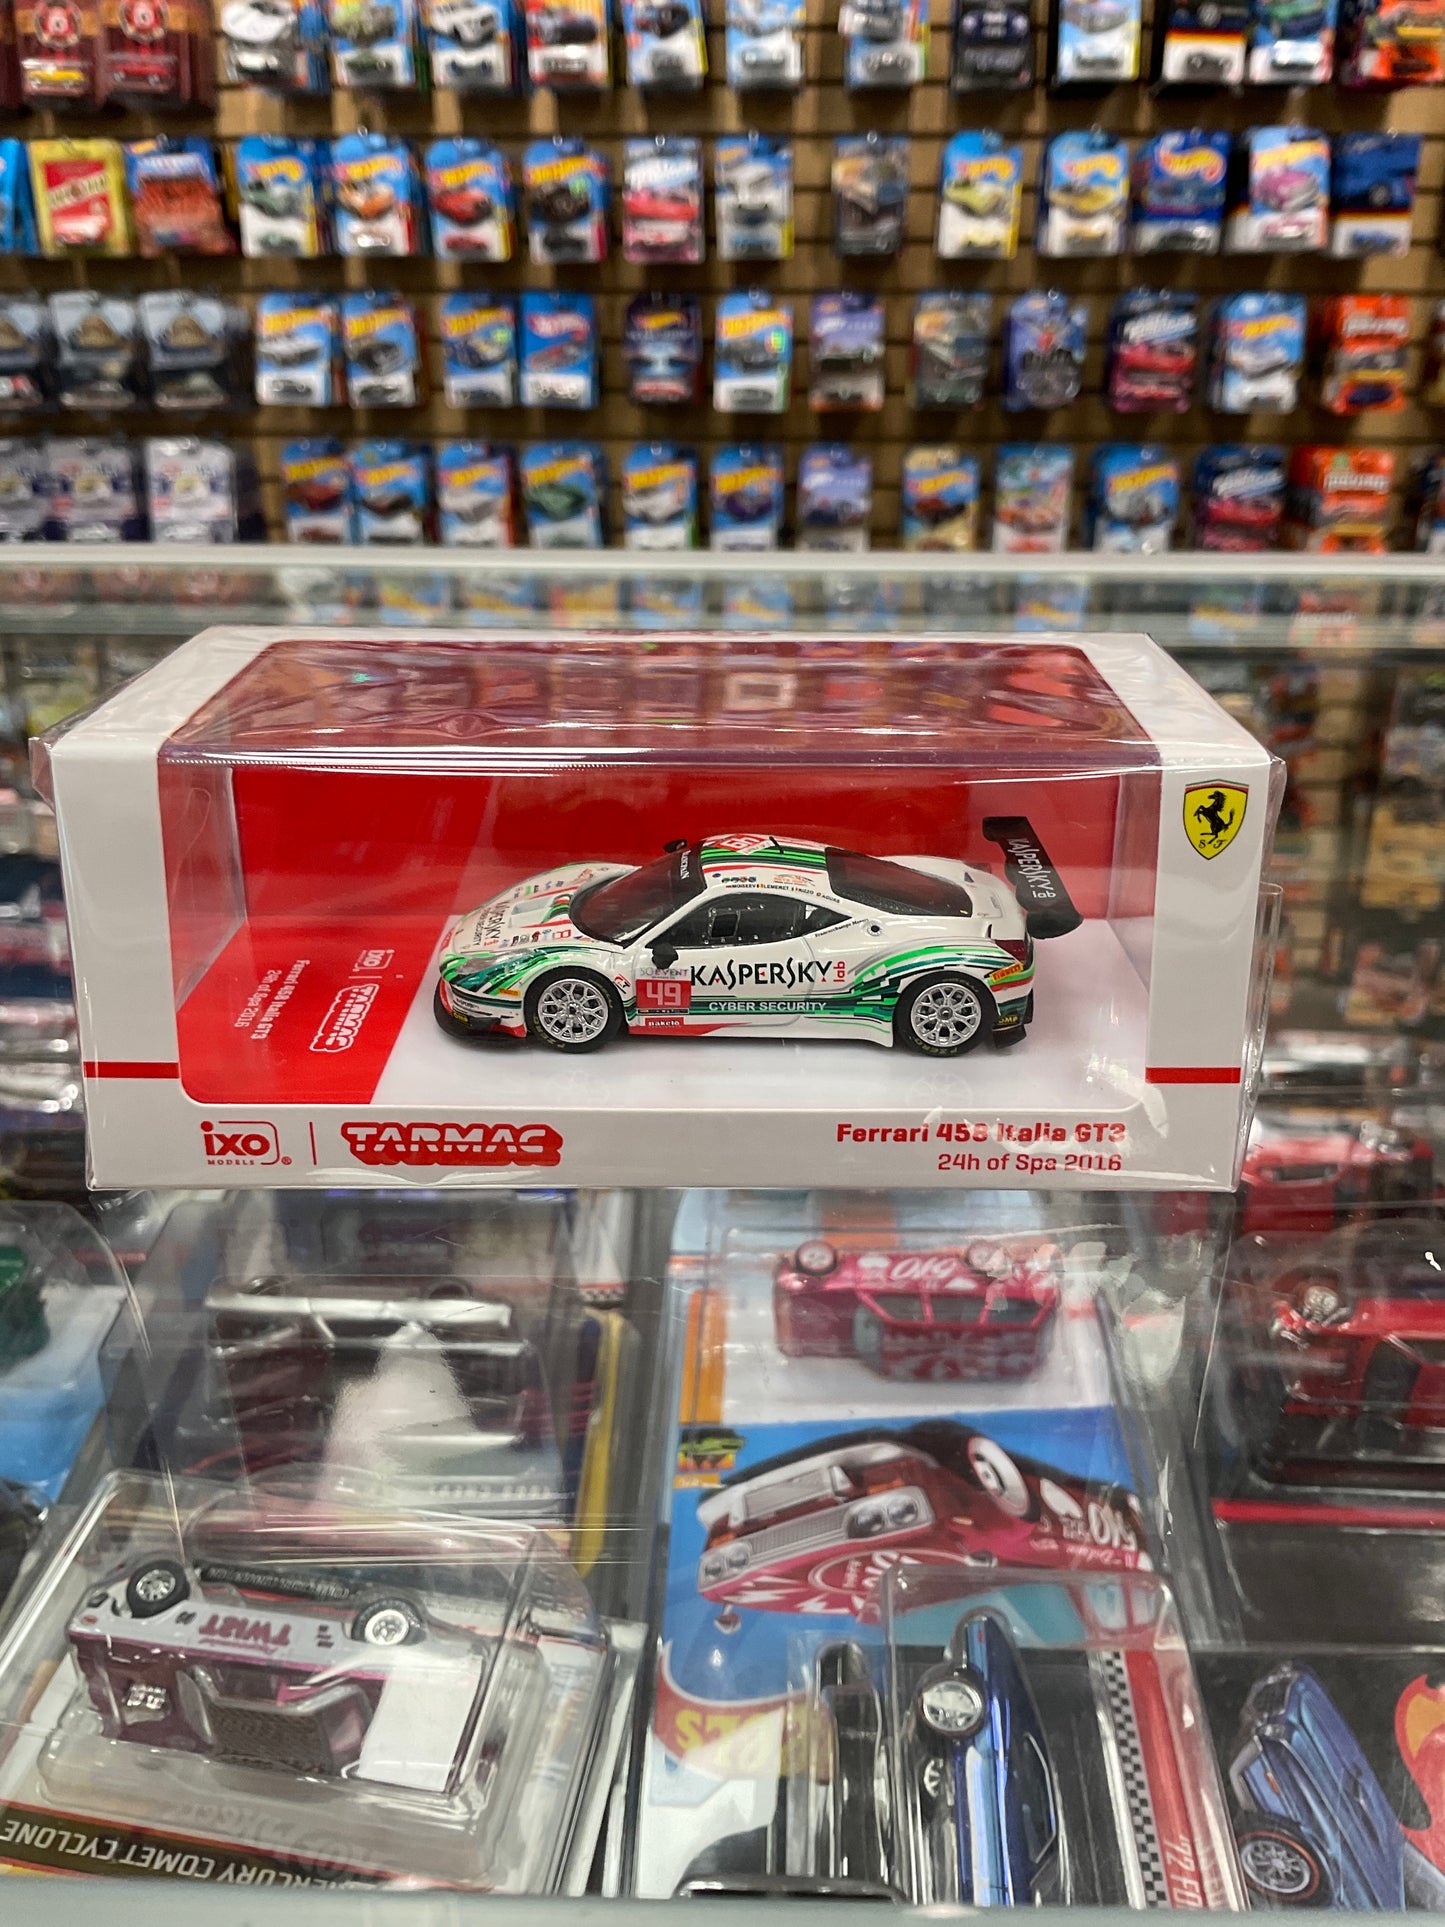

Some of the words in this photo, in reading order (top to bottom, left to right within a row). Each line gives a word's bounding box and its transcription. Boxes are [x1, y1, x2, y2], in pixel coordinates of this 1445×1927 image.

[1008, 837, 1054, 891] KASPERSKY
[1033, 890, 1056, 899] lab
[263, 969, 283, 985] 24h
[284, 959, 311, 985] Ferrari
[690, 957, 832, 990] KASPERSKY
[833, 961, 846, 982] lab
[248, 992, 268, 1006] Spa
[274, 985, 297, 1000] 458
[646, 982, 682, 1006] 49
[234, 1007, 259, 1028] 2016
[261, 1001, 287, 1023] Italia
[709, 1001, 755, 1012] CYBER
[759, 1001, 827, 1012] SECURITY
[250, 1023, 274, 1040] GT3
[200, 1121, 271, 1156] ixo
[345, 1125, 548, 1156] TARMAC
[836, 1122, 929, 1143] Ferrari
[936, 1123, 989, 1143] 458
[997, 1122, 1066, 1143] Italia
[1073, 1122, 1127, 1143] GT3
[207, 1158, 255, 1166] MODELS
[938, 1153, 981, 1171] 24h
[987, 1152, 1010, 1171] of
[1015, 1153, 1057, 1174] Spa
[1063, 1153, 1123, 1171] 2016
[0, 1818, 115, 1862] CYCLONE
[116, 1841, 218, 1879] COMET
[217, 1861, 346, 1890] ERCURY
[1170, 1873, 1204, 1909] FO
